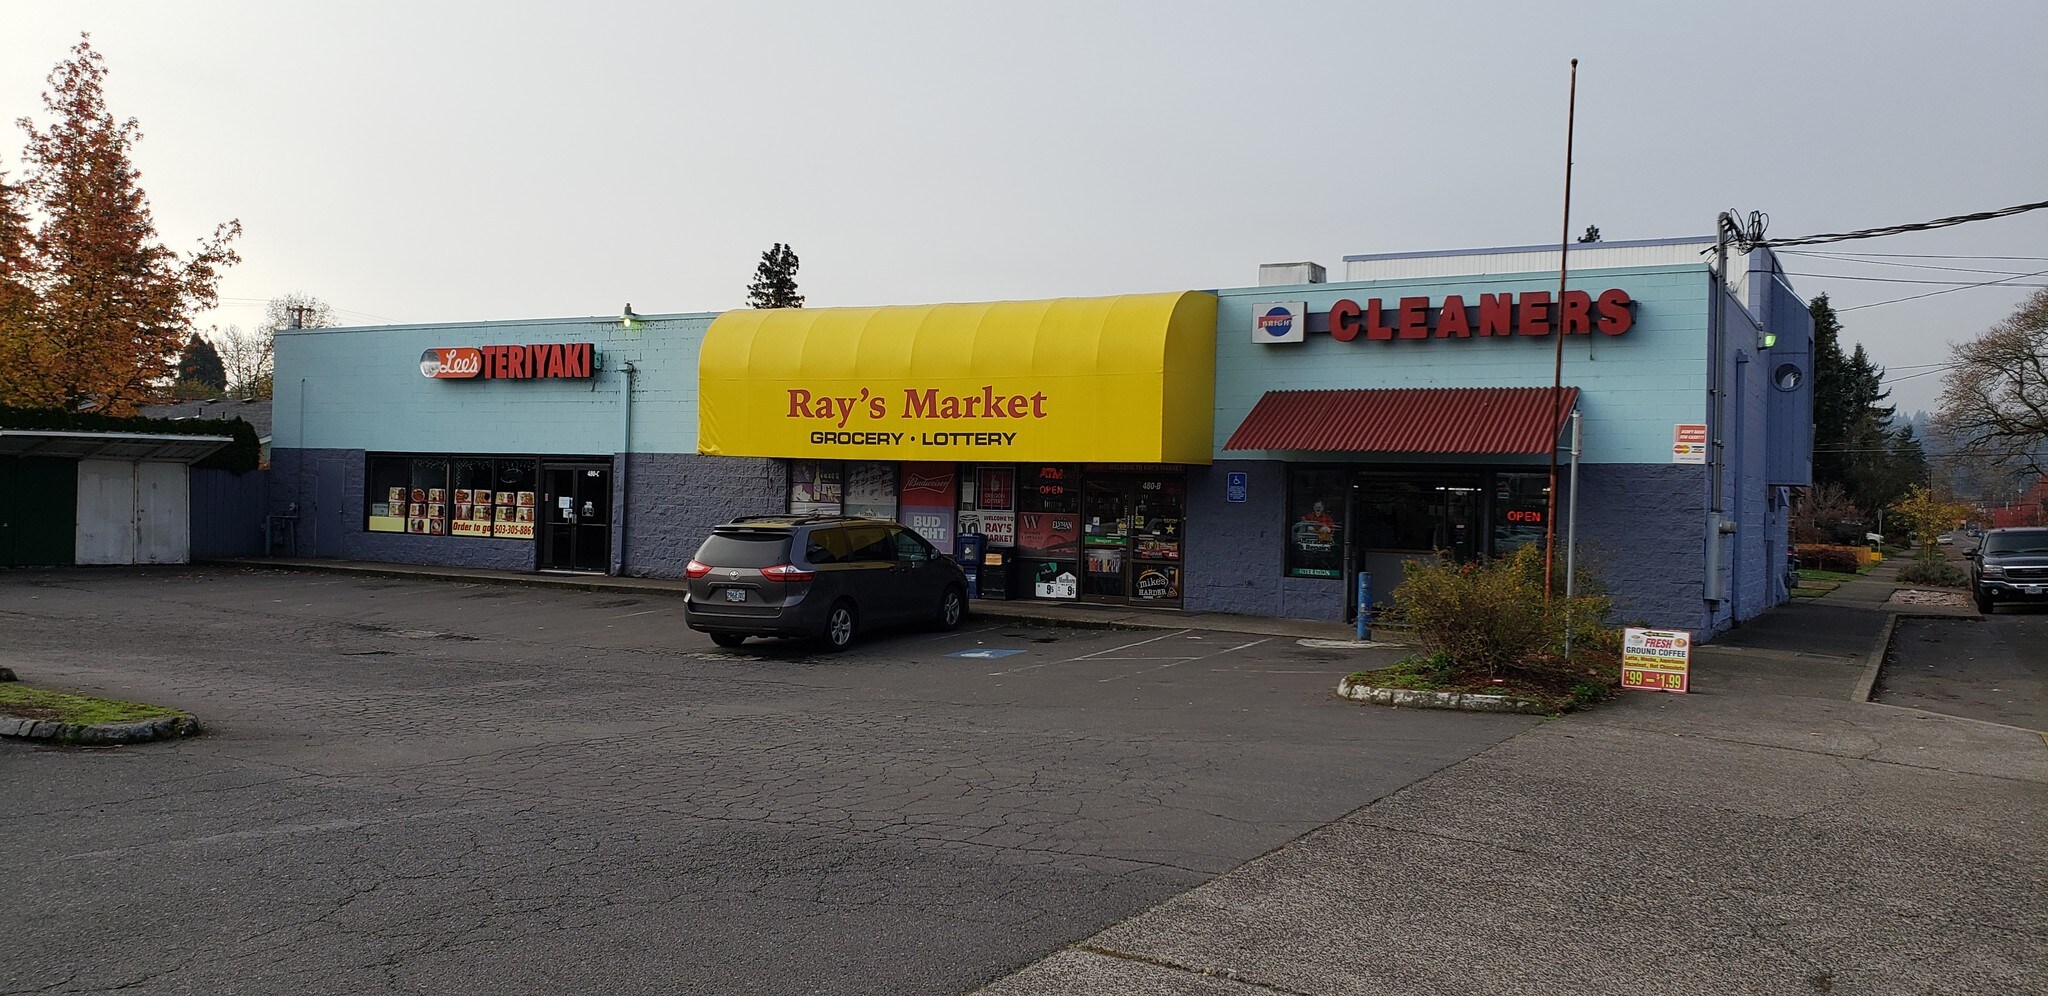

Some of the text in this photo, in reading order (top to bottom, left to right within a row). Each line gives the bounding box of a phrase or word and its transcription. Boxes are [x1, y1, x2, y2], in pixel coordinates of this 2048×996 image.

[1329, 288, 1632, 342] CLEANERS
[440, 343, 590, 378] Lee's TERIYAKI
[787, 385, 1048, 429] Ray's Market
[810, 431, 1017, 446] GROCERY LOTTERY
[907, 477, 949, 488] Budweiser
[1040, 485, 1064, 495] OPEN
[913, 515, 941, 528] BUD
[1506, 510, 1541, 522] OPEN
[453, 522, 492, 534] Order to go
[985, 523, 1013, 533] RAY'S
[1139, 577, 1166, 589] mike's
[1645, 638, 1673, 648] FRESH
[1626, 647, 1686, 657] GROUND COFFEE
[1656, 674, 1682, 688] $1.99
